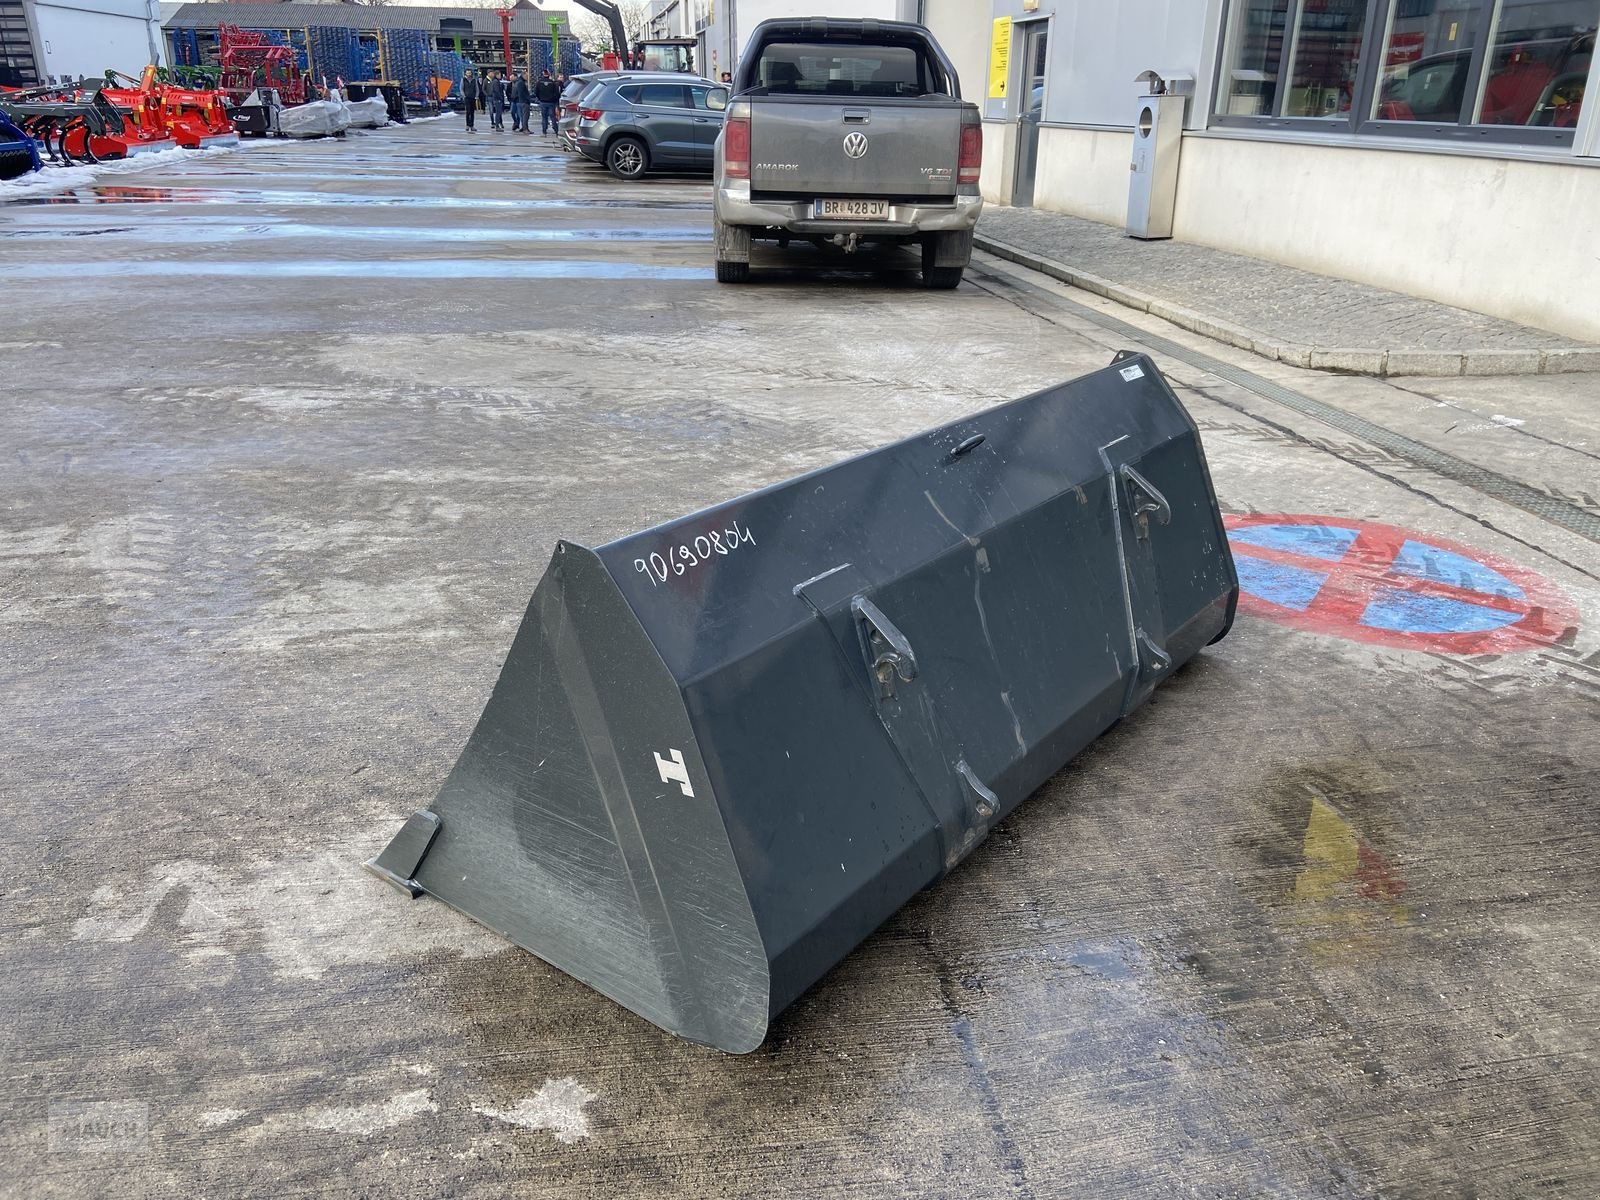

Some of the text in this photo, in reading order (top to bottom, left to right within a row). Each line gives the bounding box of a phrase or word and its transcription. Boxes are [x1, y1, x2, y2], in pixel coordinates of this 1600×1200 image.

[755, 163, 799, 171] AMAROK
[920, 167, 933, 175] V6
[824, 201, 884, 215] BR 428 JV
[634, 521, 756, 587] 90690804
